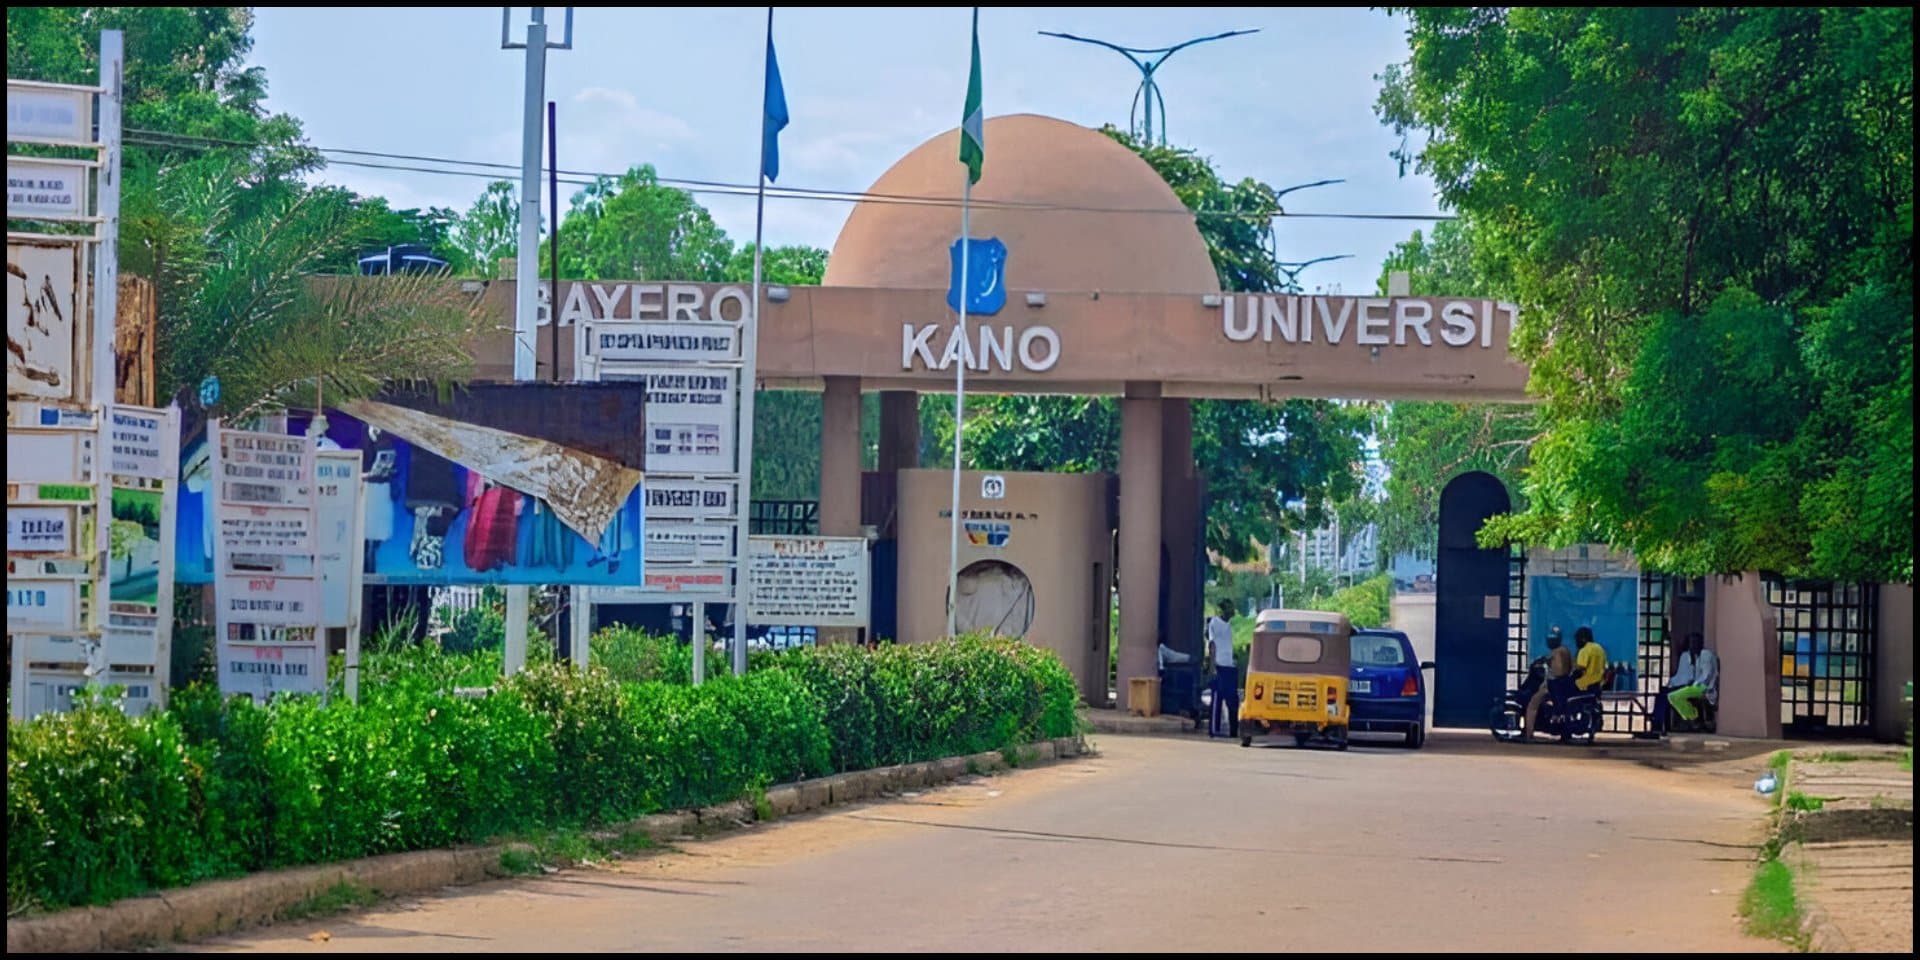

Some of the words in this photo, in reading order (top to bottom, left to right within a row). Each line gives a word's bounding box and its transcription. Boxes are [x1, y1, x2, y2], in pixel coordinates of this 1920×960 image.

[536, 281, 751, 327] BAYERO
[1223, 296, 1519, 348] UNIVERSIT
[902, 323, 1061, 372] KANO
